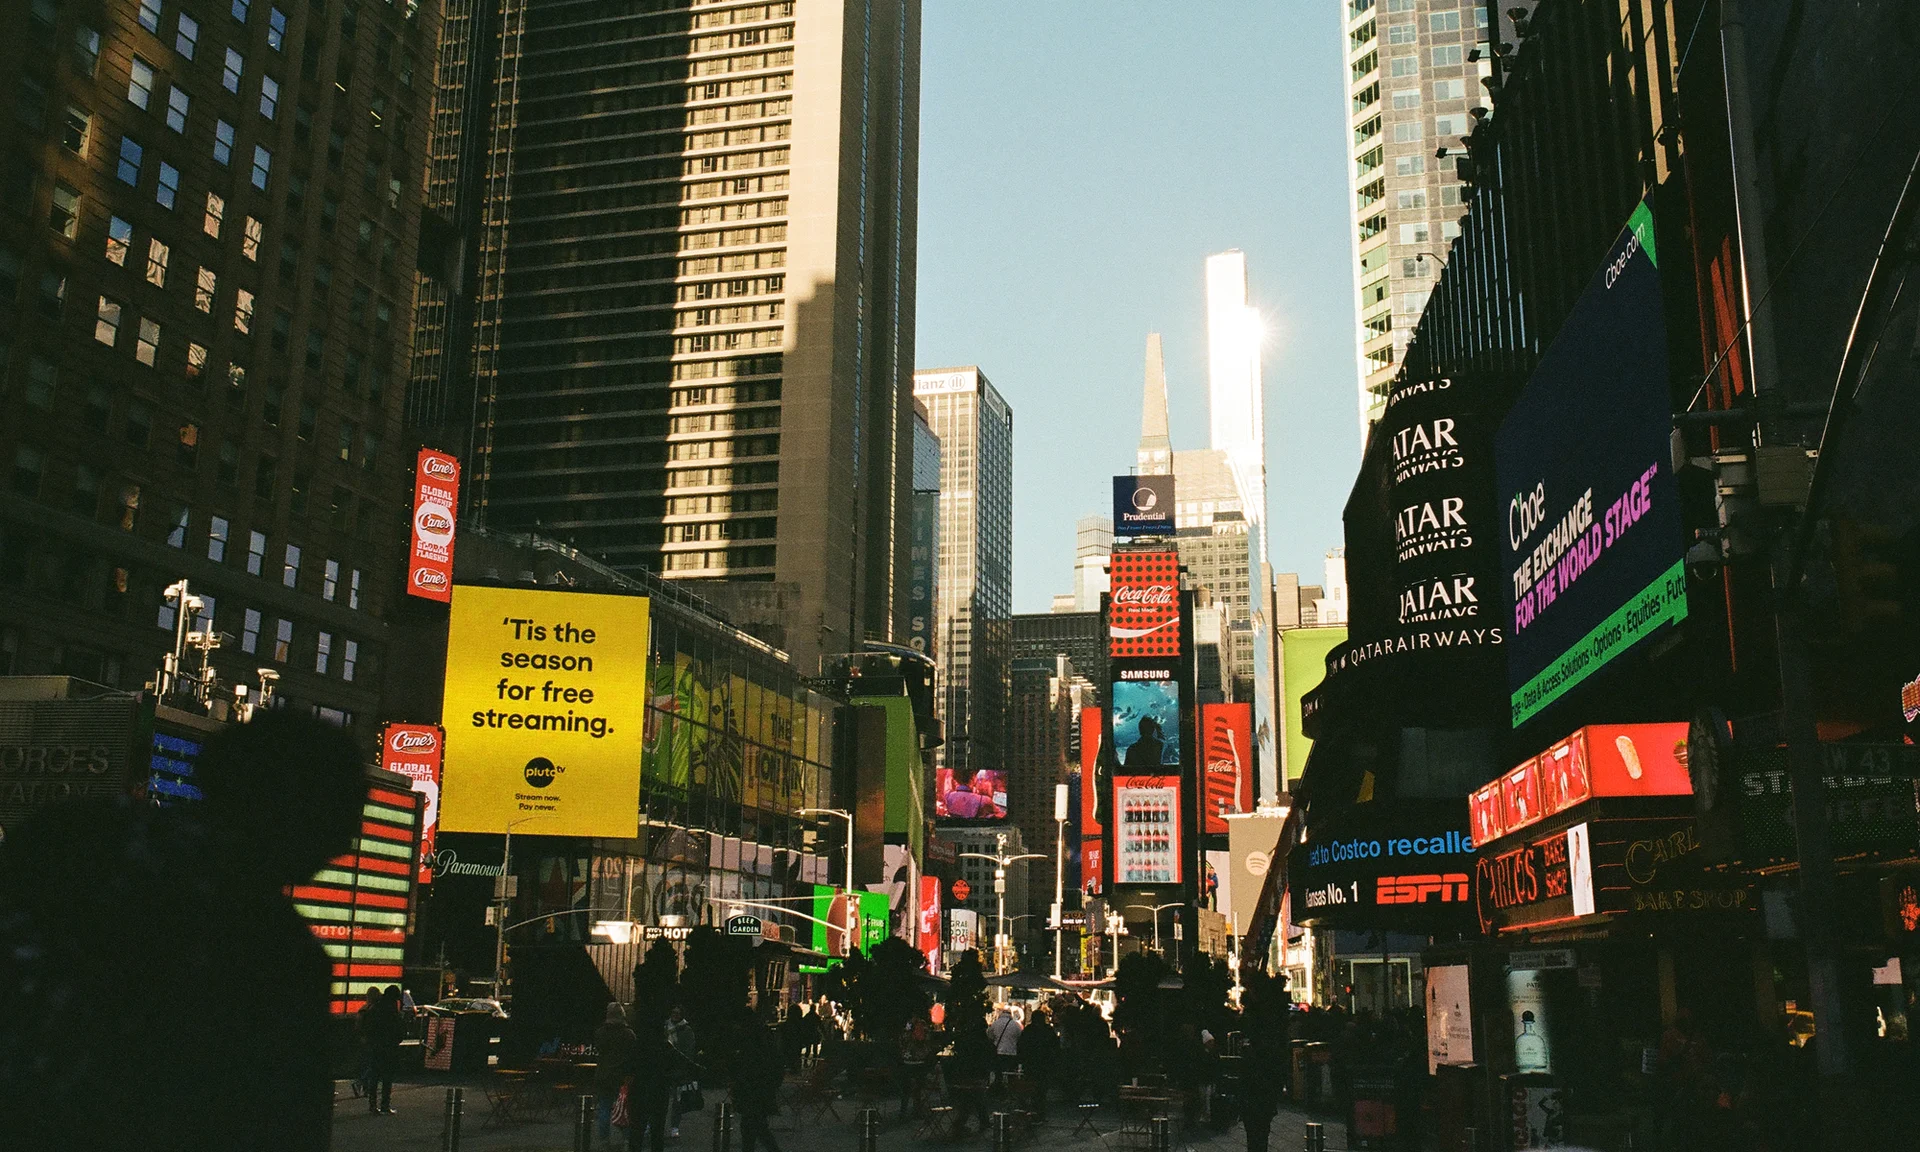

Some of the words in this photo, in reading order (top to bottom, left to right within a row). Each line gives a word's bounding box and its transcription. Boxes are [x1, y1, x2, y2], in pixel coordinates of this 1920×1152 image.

[1606, 223, 1645, 289] Cboe.com
[422, 457, 455, 476] Cane's
[421, 485, 453, 501] GLOBAL
[419, 513, 451, 530] Cane's
[1123, 512, 1166, 521] Prudential
[1509, 482, 1546, 551] Cboe
[417, 541, 449, 556] GLOBAL
[1513, 556, 1532, 601] THE
[1533, 486, 1592, 581] EXCHANGE
[416, 551, 449, 564] FLAGSHIP
[911, 507, 928, 600] TIMES
[414, 567, 447, 585] Cane's
[1515, 590, 1535, 635] FOR
[1535, 567, 1557, 614] THE
[1558, 522, 1602, 593] WORLD
[1114, 585, 1174, 605] Coca-Cola
[502, 617, 547, 641] 'Tis
[553, 622, 596, 644] the
[1593, 623, 1622, 660] Options
[1625, 593, 1660, 634] Equities
[500, 651, 593, 672] season
[1121, 669, 1170, 679] SAMSUNG
[496, 678, 535, 701] for
[542, 680, 594, 704] free
[472, 709, 615, 738] streaming.
[391, 731, 436, 750] Cane's
[390, 762, 433, 774] GLOBAL
[515, 792, 543, 801] Stream
[518, 803, 533, 811] Pay
[1320, 845, 1330, 864] to
[1331, 838, 1381, 863] Costco
[1327, 882, 1347, 905] No.
[1351, 880, 1358, 903] 1
[1376, 873, 1469, 905] ESPN
[732, 925, 759, 933] GARDEN
[737, 917, 754, 925] BEER
